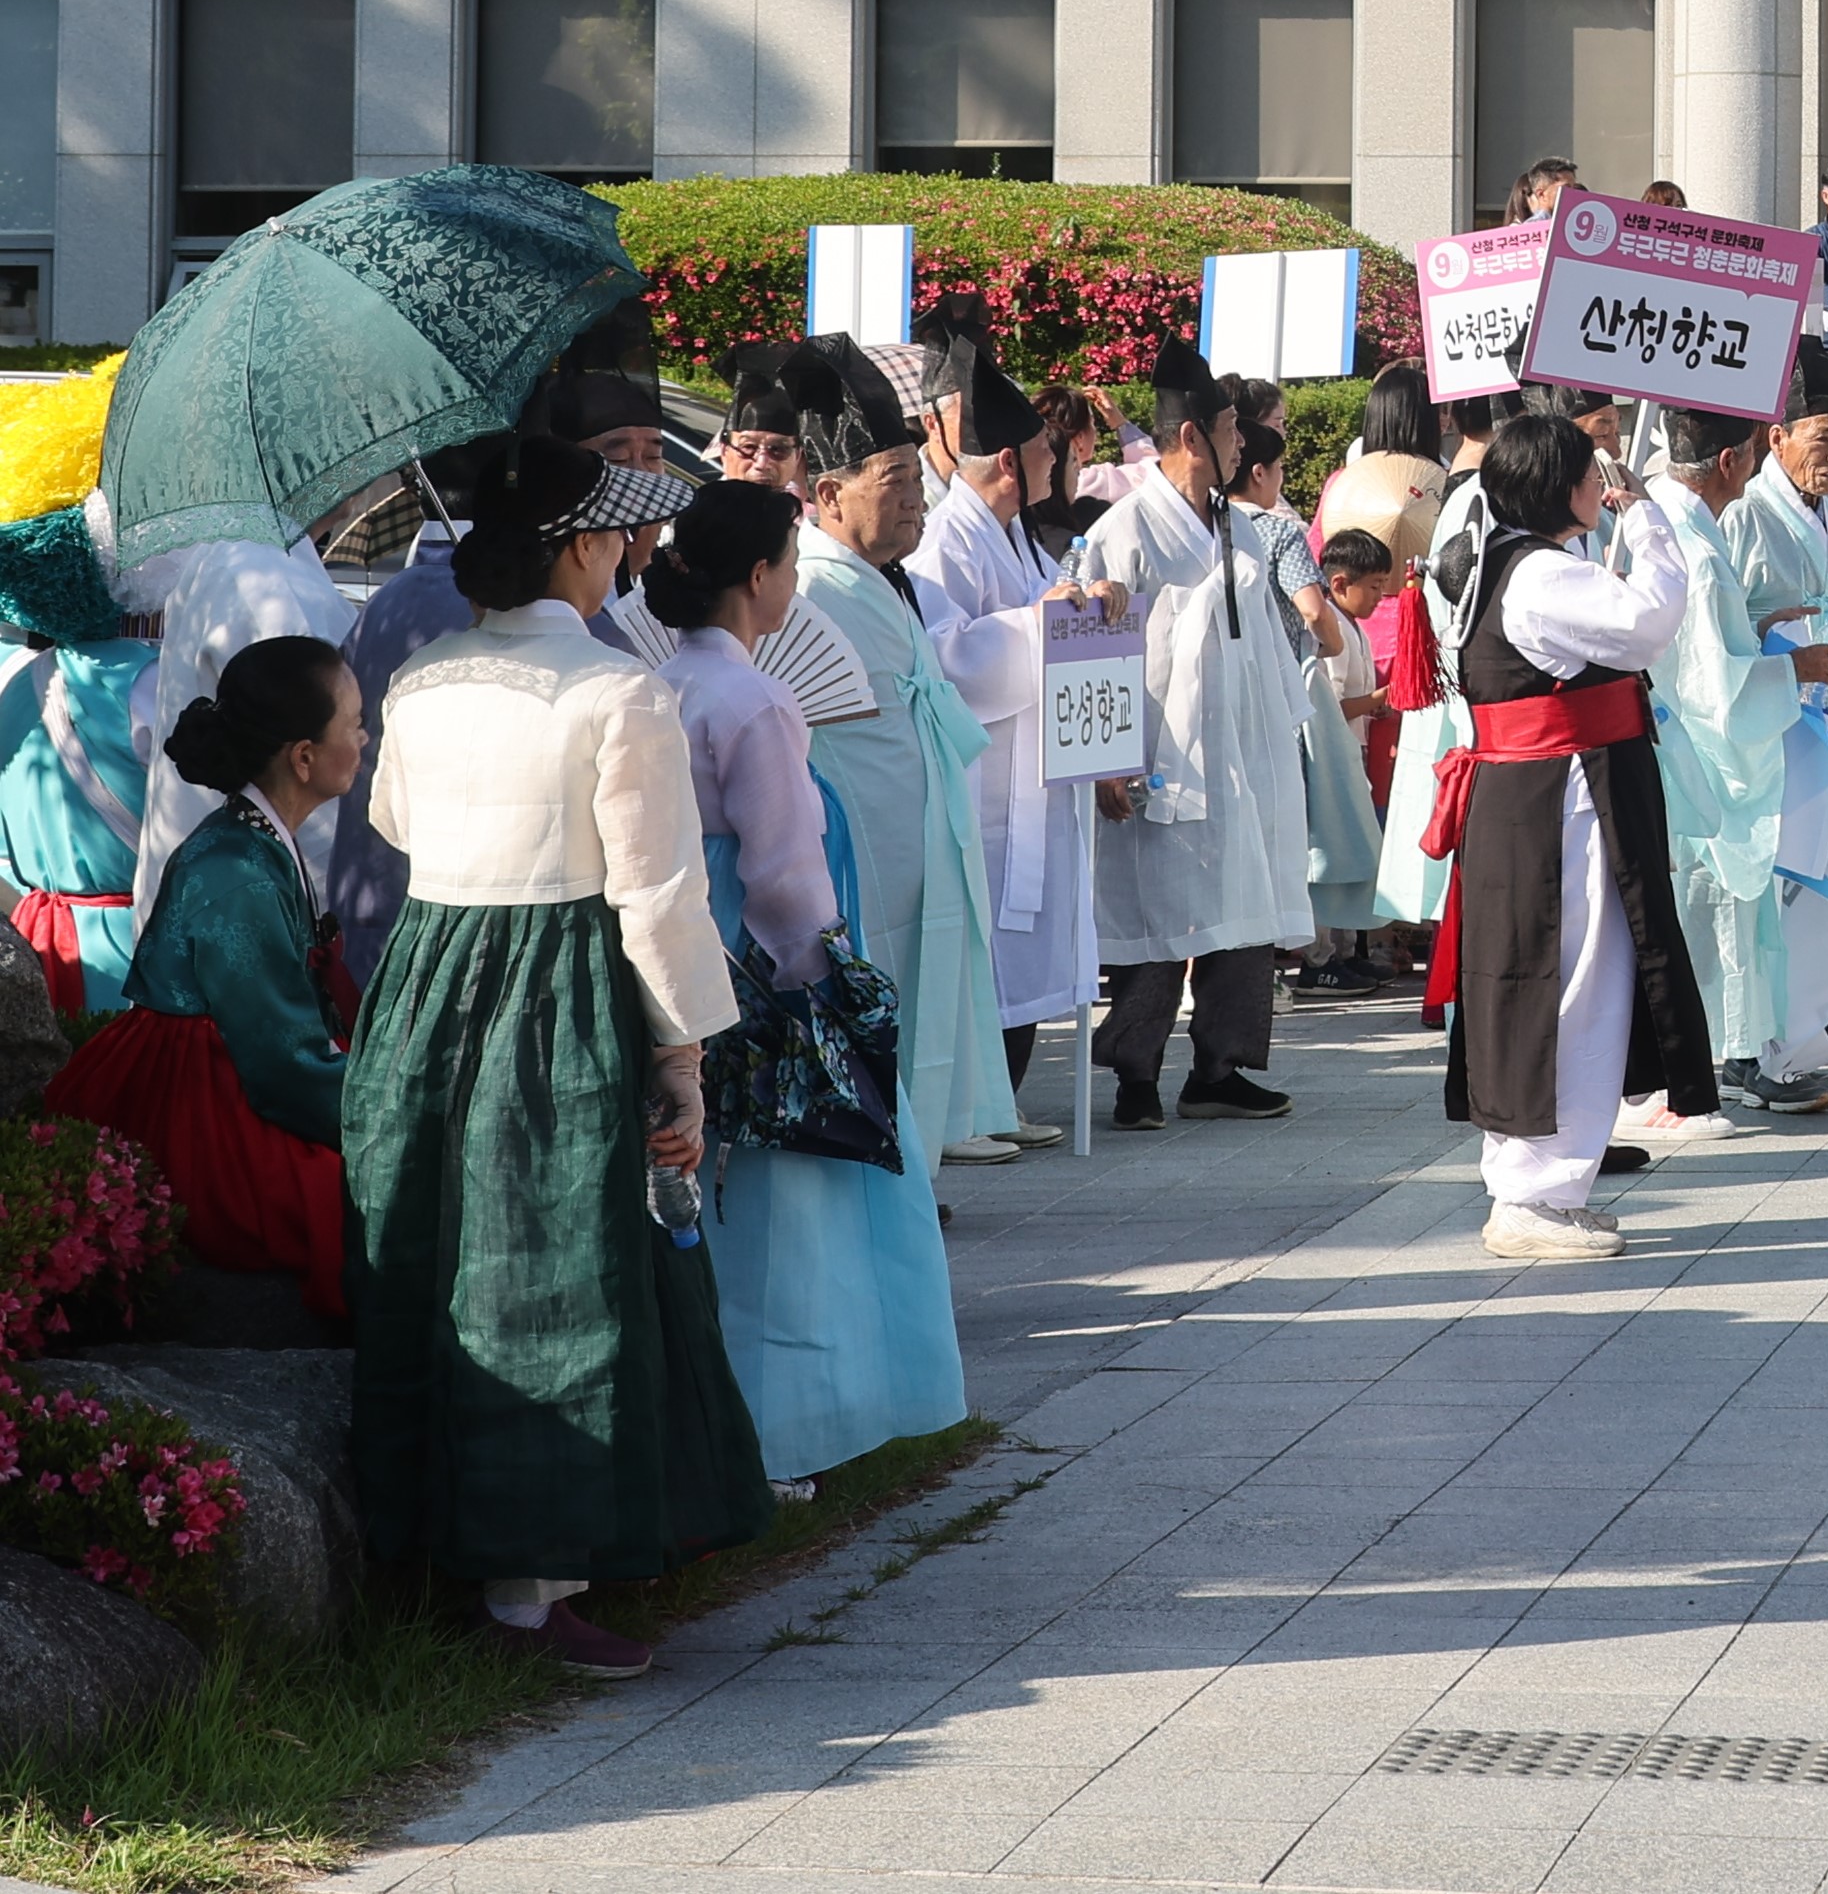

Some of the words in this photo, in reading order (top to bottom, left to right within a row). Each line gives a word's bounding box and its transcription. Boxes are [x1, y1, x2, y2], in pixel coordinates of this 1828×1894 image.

[1471, 240, 1494, 254] 산청
[1497, 232, 1542, 250] 구석구석
[1574, 210, 1609, 244] 9월
[1623, 213, 1651, 232] 산청
[1654, 218, 1708, 241] 구석구석
[1711, 229, 1765, 252] 문화축제
[1472, 249, 1533, 277] 두근두근
[1617, 232, 1690, 266] 두근두근
[1693, 246, 1798, 286] 청춘문화축제
[1580, 296, 1750, 370] 산청향교
[1056, 678, 1133, 747] 단성향교
[1317, 973, 1339, 986] GAP
